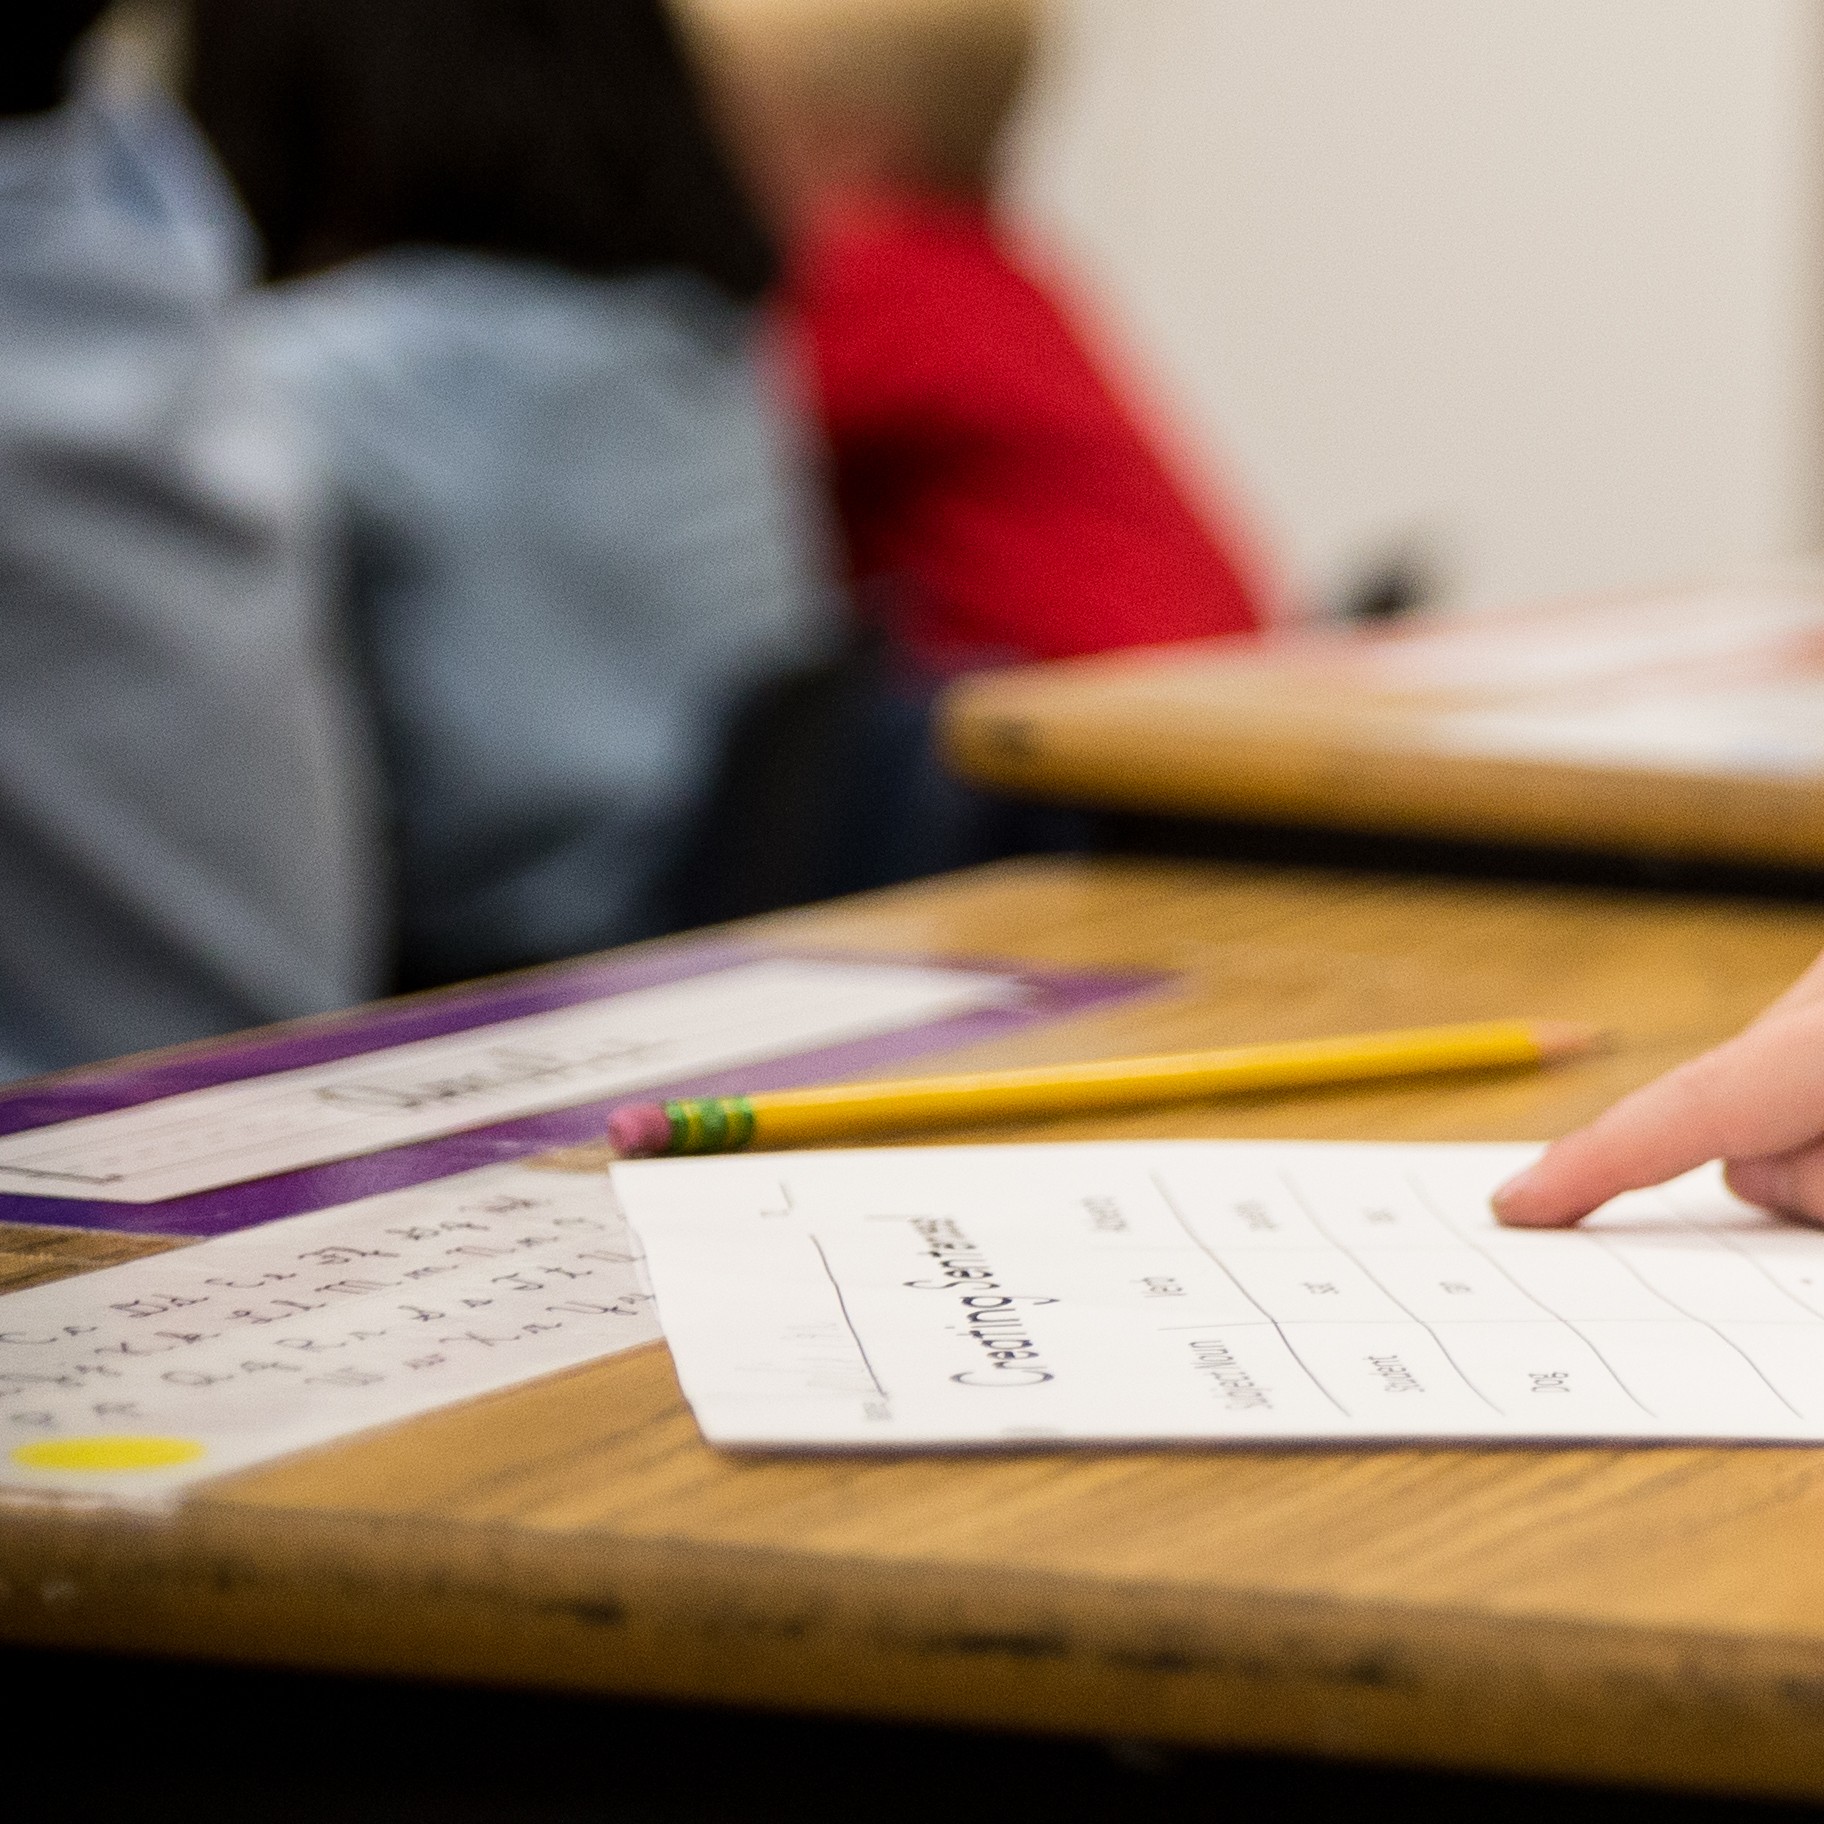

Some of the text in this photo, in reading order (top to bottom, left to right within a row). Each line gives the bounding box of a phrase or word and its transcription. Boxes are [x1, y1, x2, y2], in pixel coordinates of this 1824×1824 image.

[944, 1294, 1061, 1387] Creating
[1187, 1339, 1242, 1370] Noun
[1362, 1353, 1426, 1393] Student
[1527, 1370, 1571, 1394] Dog
